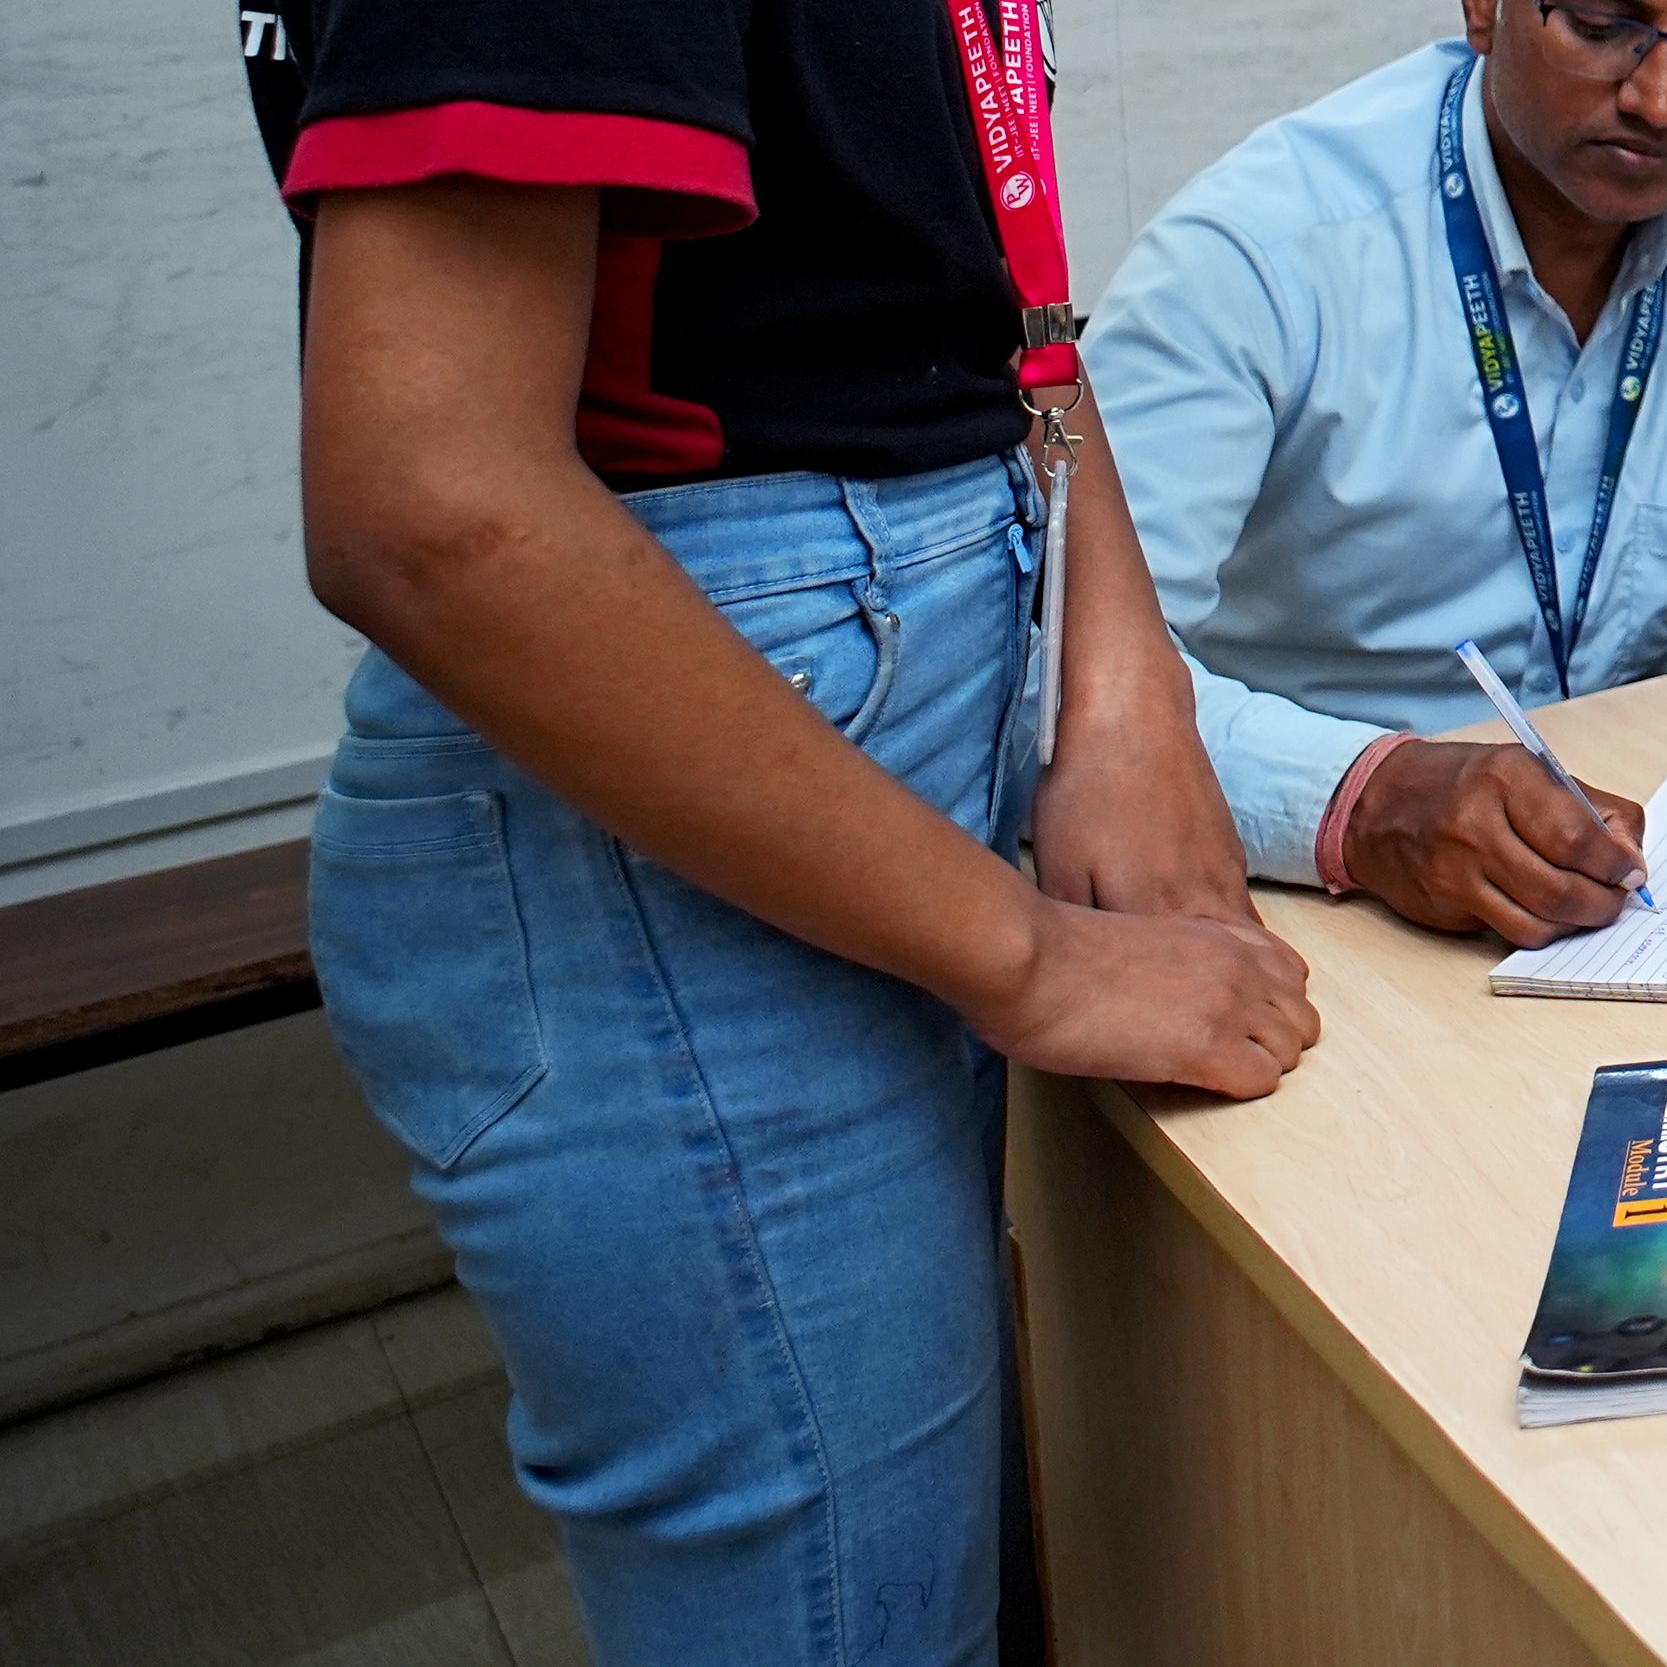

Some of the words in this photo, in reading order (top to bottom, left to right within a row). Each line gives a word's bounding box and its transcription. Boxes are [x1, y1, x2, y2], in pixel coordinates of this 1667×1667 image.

[975, 1, 999, 78] FOUNDATION
[1001, 1, 1025, 115] APEETH
[1021, 4, 1034, 79] FOUNDATION
[958, 6, 1012, 174] VIDYAPEETH
[1027, 87, 1039, 114] NEET
[1463, 274, 1504, 393] VIDYAPEETH
[1625, 283, 1657, 371] VIDYAPEE
[1622, 1138, 1655, 1197] Module
